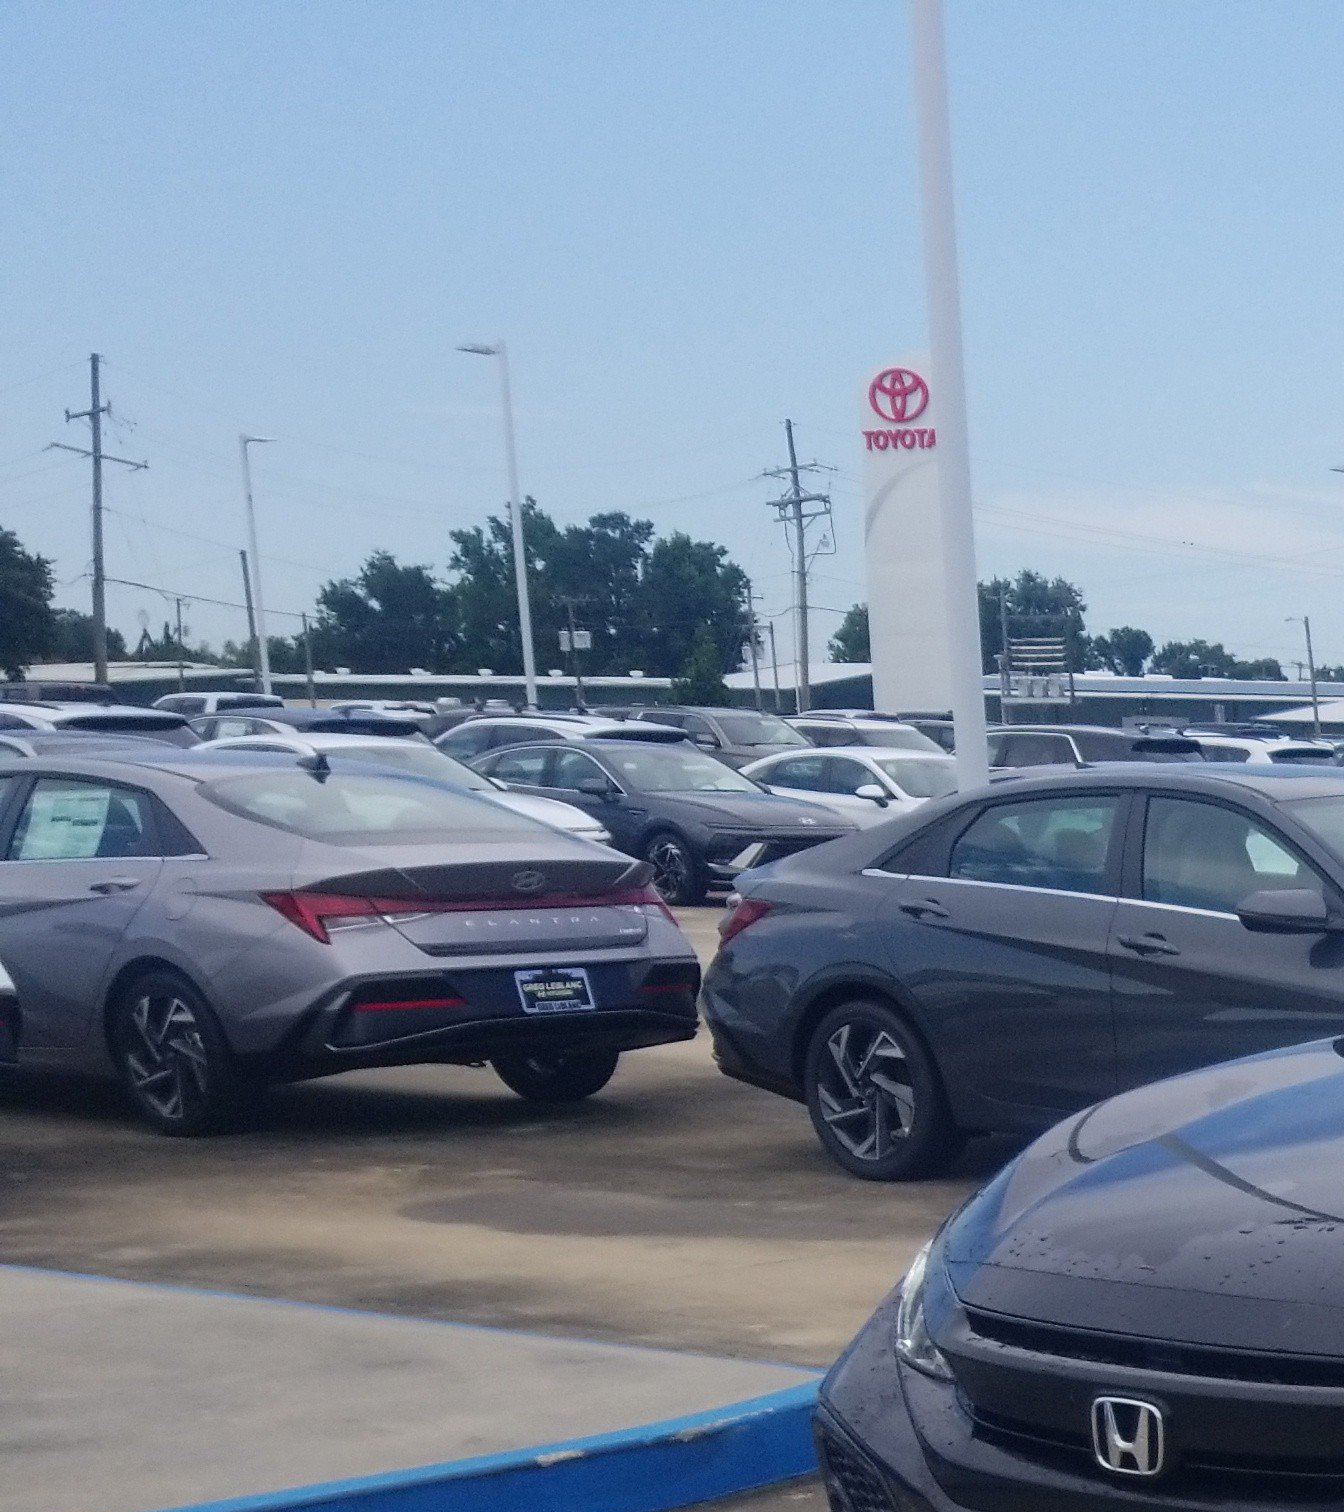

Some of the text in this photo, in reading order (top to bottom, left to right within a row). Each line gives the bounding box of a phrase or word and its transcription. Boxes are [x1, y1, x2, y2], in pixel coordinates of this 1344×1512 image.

[862, 428, 936, 451] TOYOTA
[465, 915, 601, 927] ELANTRA
[522, 982, 545, 992] GREG
